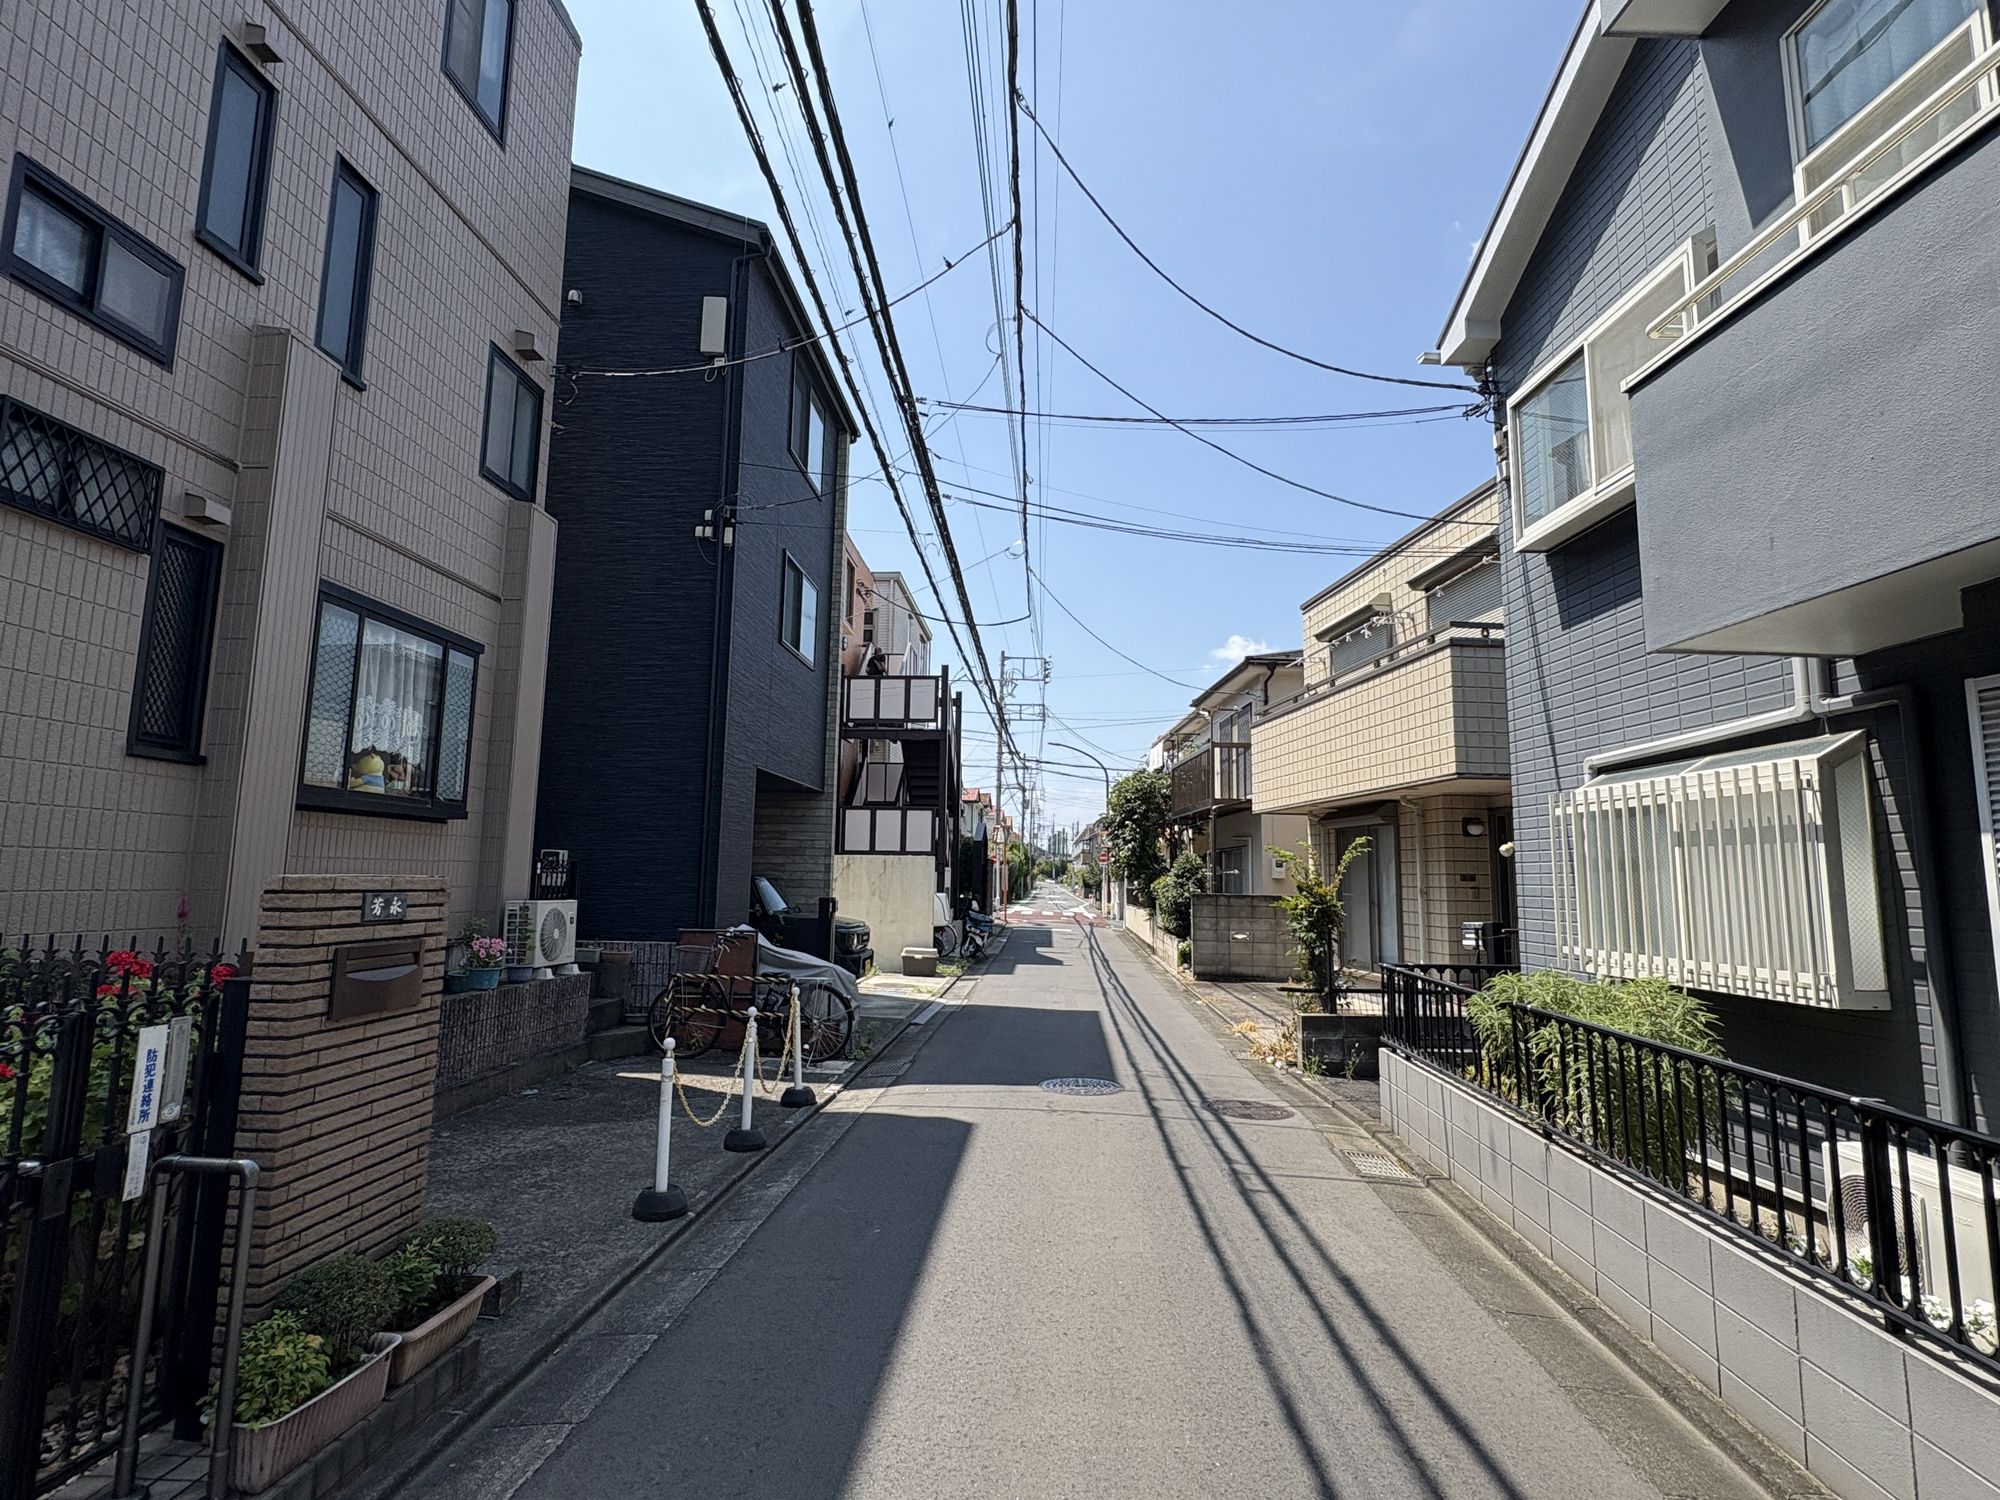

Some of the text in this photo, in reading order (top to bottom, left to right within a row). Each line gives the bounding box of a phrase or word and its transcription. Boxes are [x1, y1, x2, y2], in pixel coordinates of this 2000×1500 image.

[137, 1048, 159, 1125] 防犯連絡所
